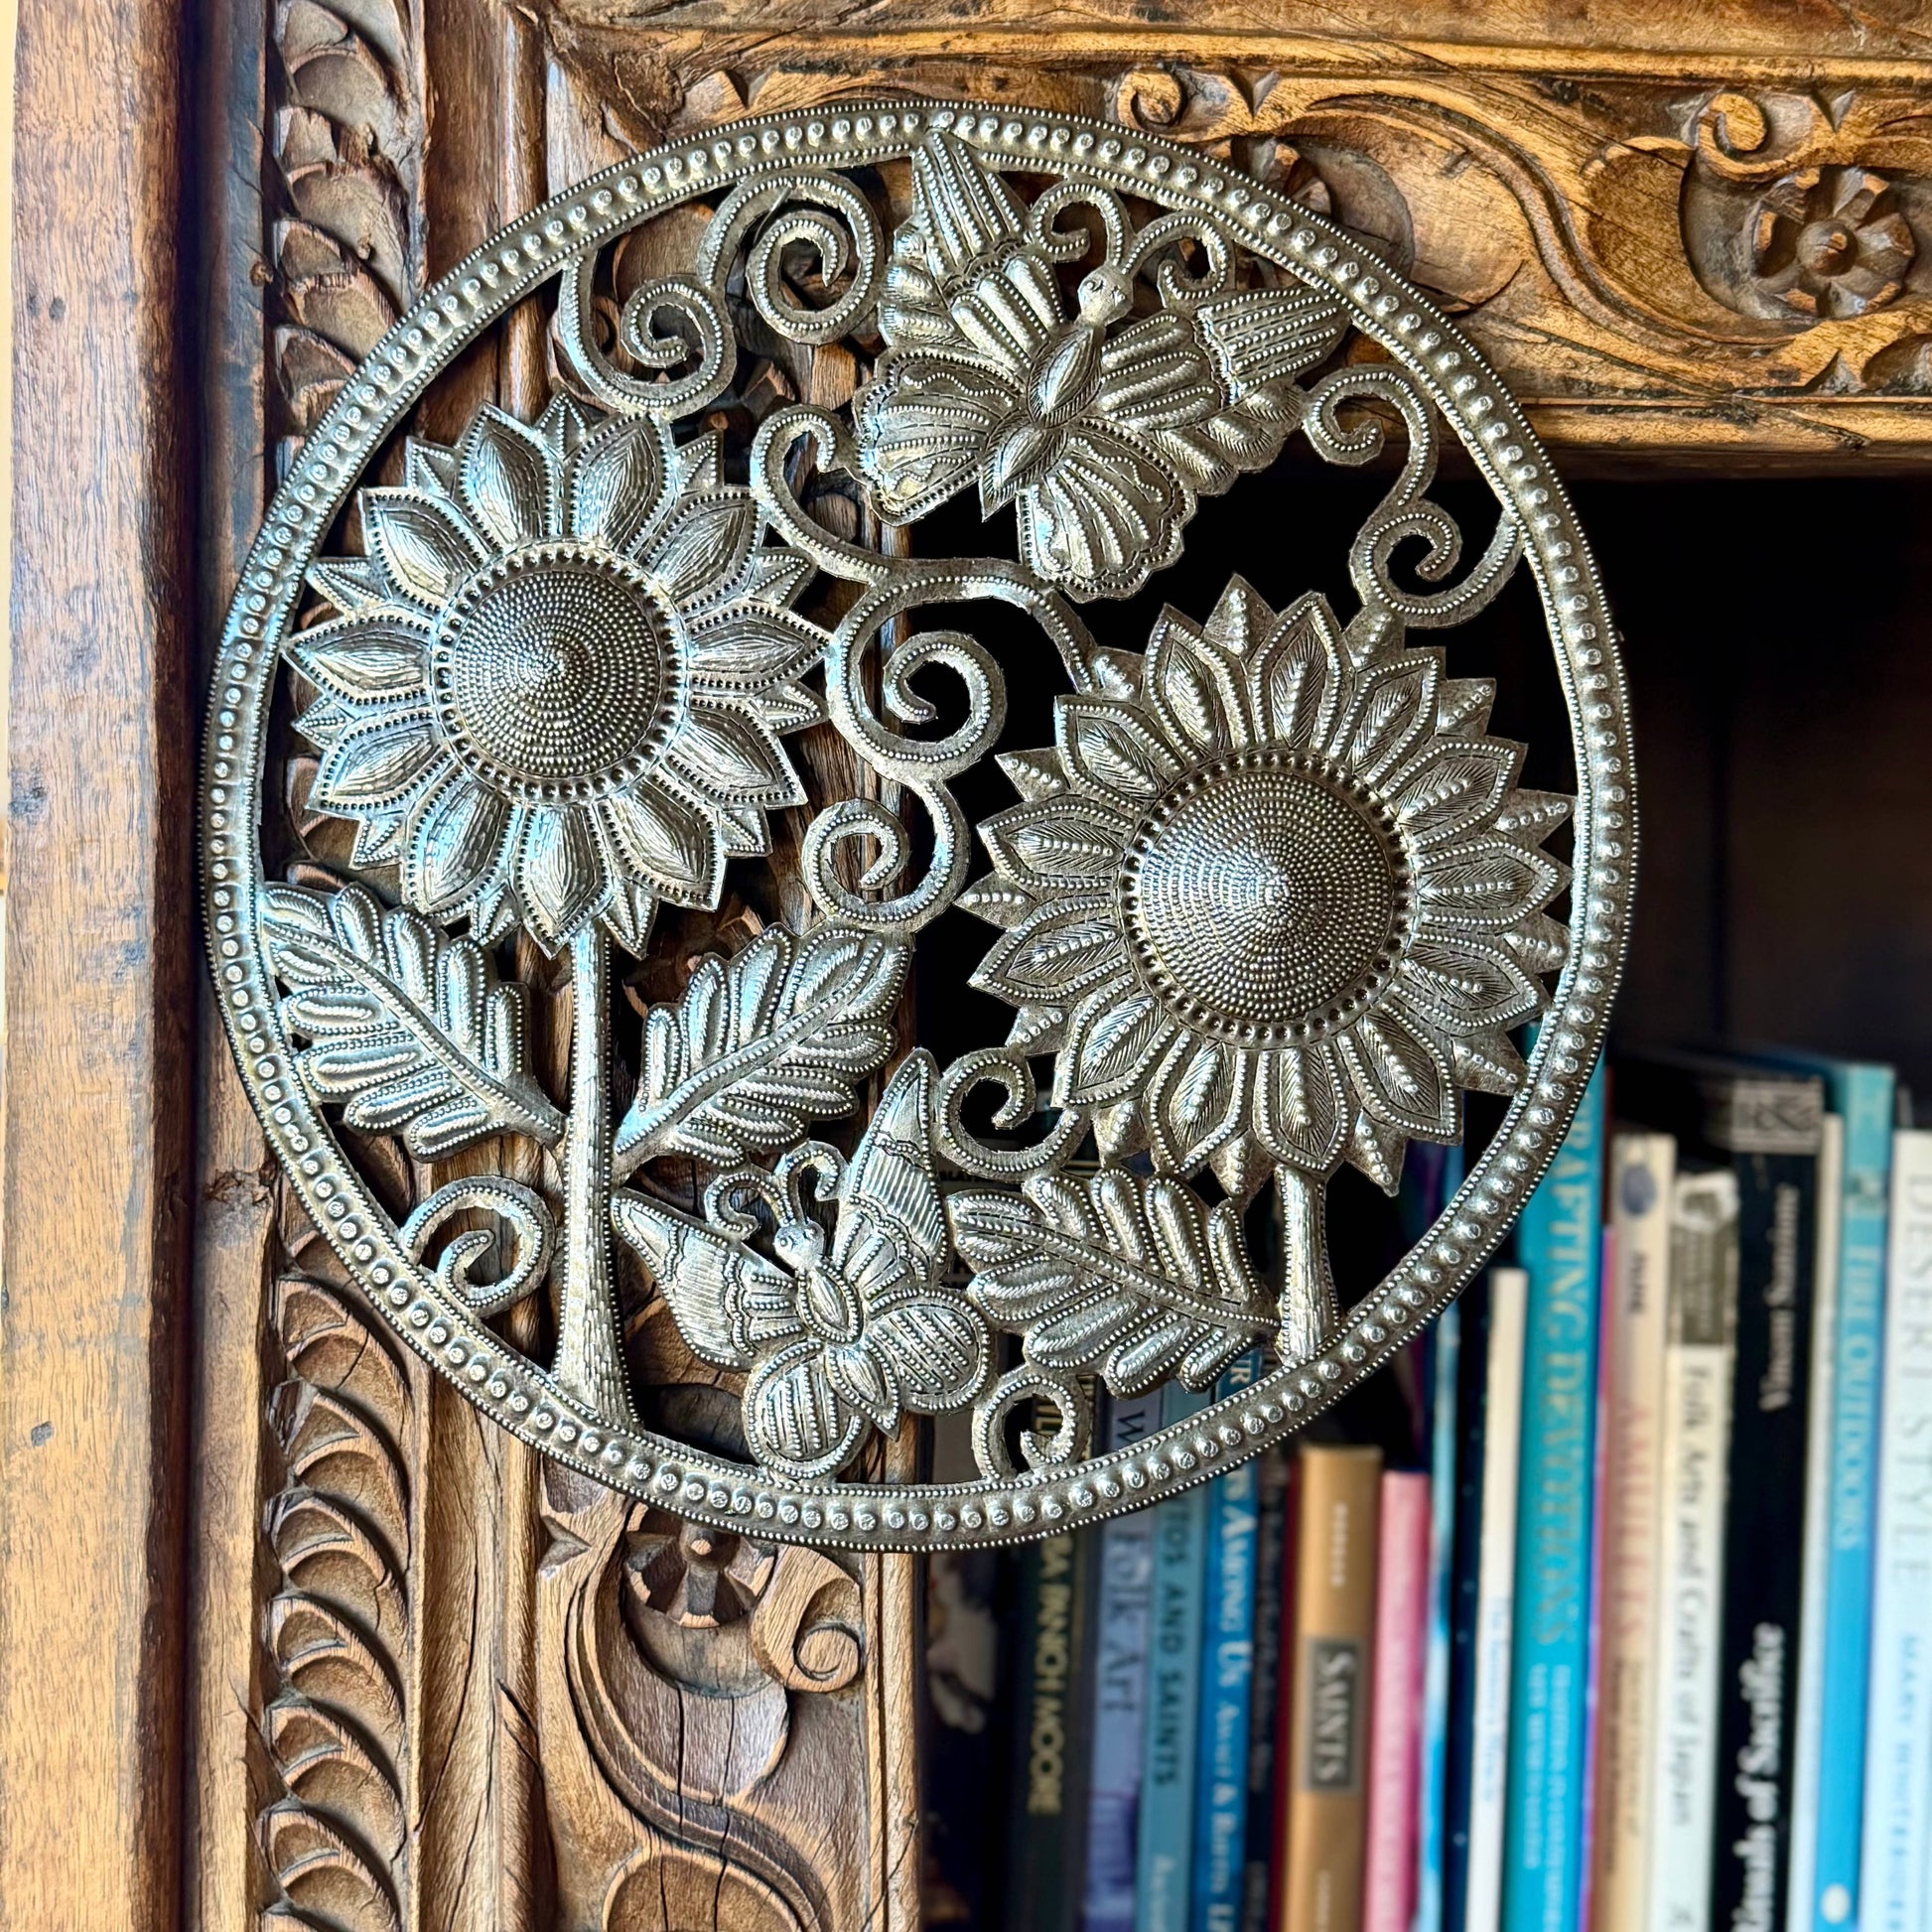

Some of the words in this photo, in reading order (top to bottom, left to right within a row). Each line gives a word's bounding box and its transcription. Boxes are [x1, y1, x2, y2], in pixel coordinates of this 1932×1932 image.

[1546, 1096, 1592, 1340] RAFTING
[1684, 1364, 1714, 1431] Folk
[1677, 1448, 1710, 1505] Arts
[1833, 1333, 1878, 1551] OUTDOORS
[1533, 1348, 1586, 1646] DEVOTIONS
[1678, 1516, 1708, 1580] and
[1161, 1583, 1188, 1656] AND
[1674, 1587, 1709, 1681] Crafts
[1104, 1641, 1143, 1713] Art
[1674, 1691, 1703, 1725] of
[1735, 1623, 1786, 1775] Sacrifice
[1026, 1696, 1066, 1817] MOORE
[1154, 1670, 1183, 1786] SAINTS
[1211, 1784, 1238, 1808] &
[1669, 1734, 1702, 1827] Japan
[1733, 1773, 1779, 1821] of
